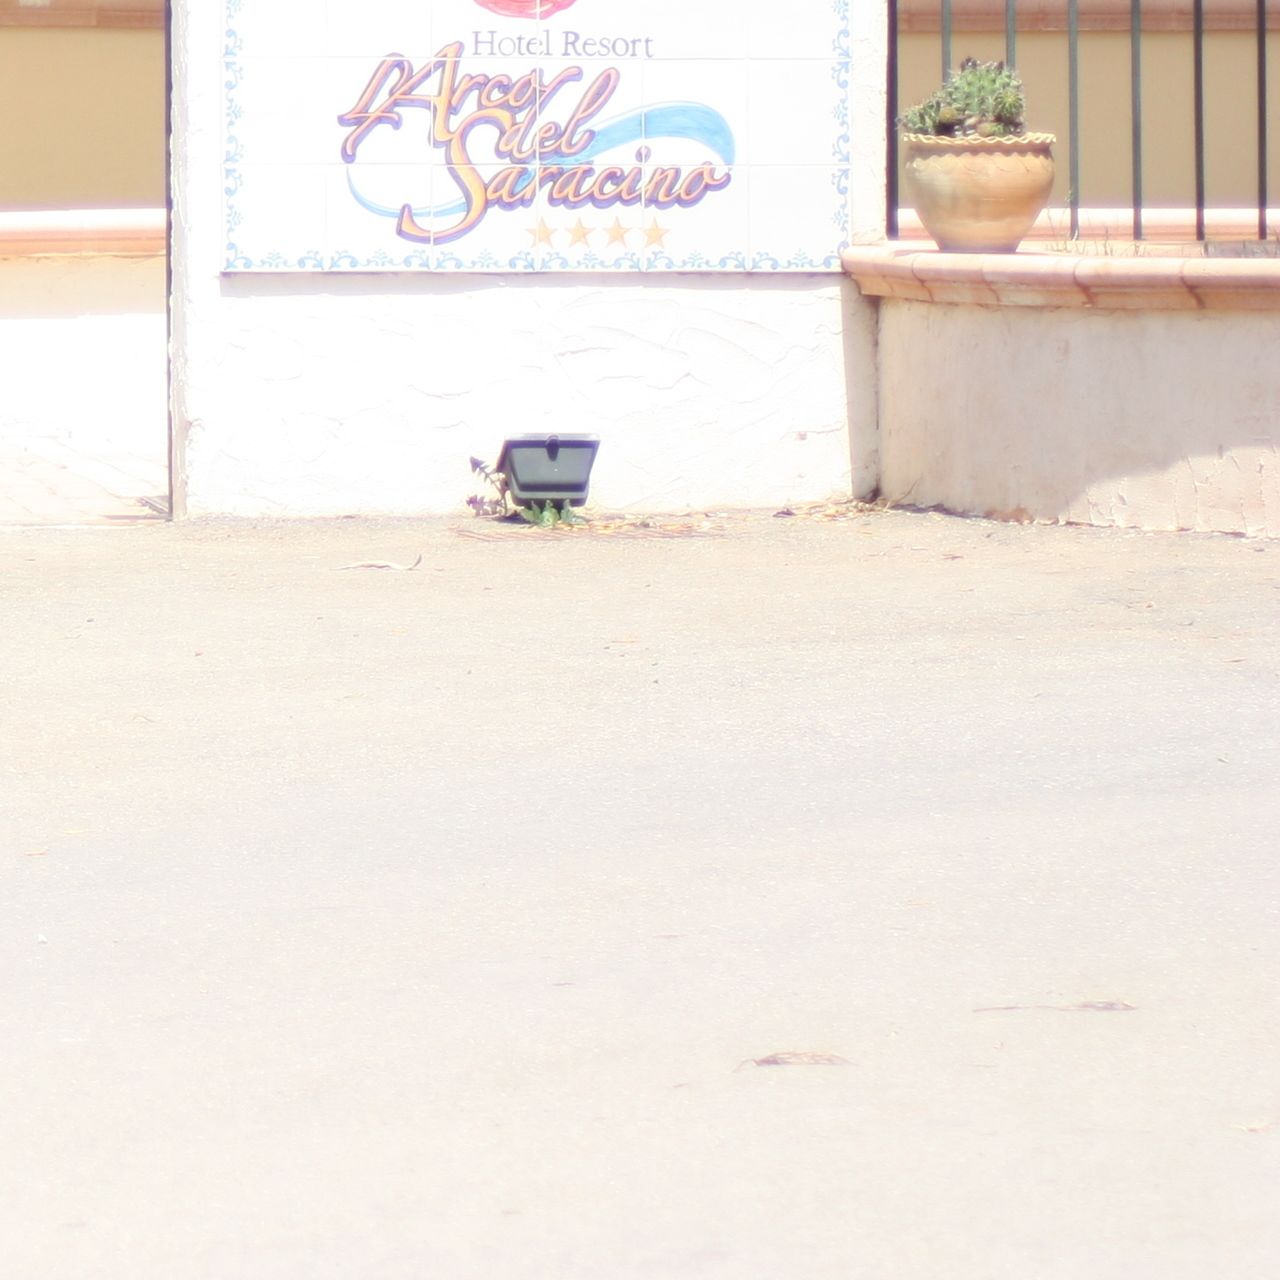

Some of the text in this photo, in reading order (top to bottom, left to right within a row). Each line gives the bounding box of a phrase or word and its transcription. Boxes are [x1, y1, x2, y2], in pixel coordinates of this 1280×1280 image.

[472, 29, 655, 58] Hotel Resort
[494, 66, 620, 163] del
[396, 108, 732, 245] Saracino
